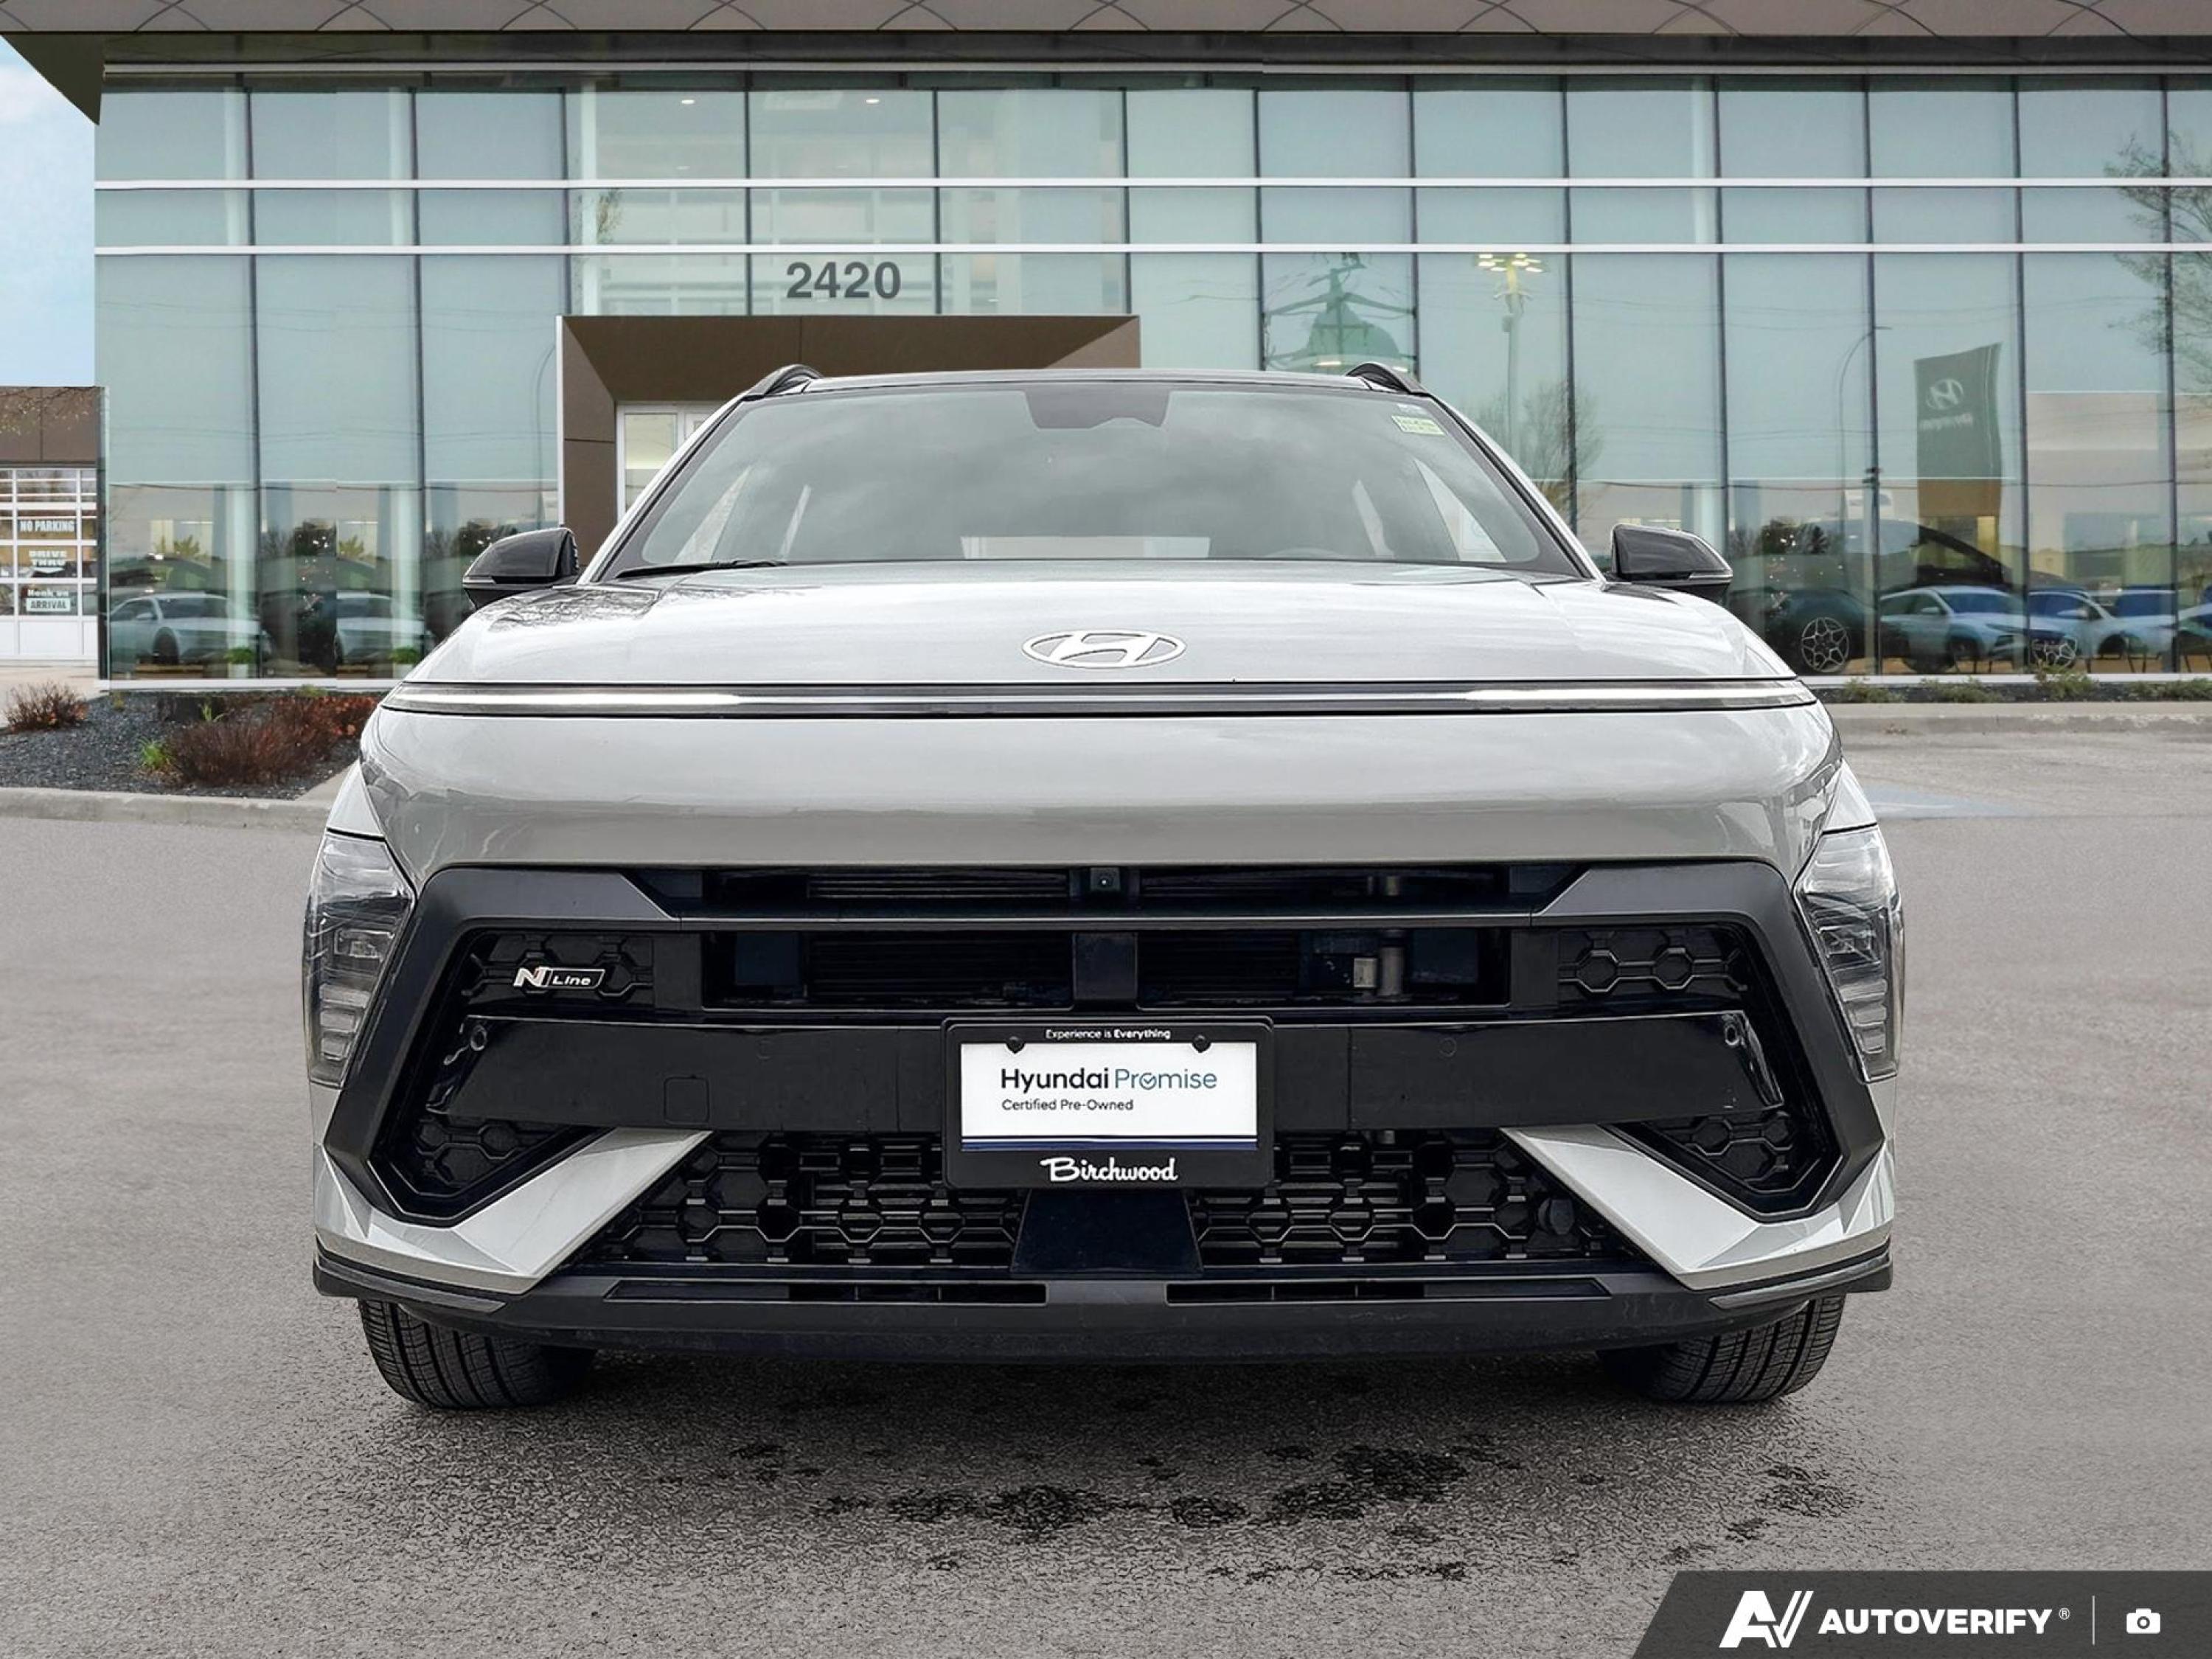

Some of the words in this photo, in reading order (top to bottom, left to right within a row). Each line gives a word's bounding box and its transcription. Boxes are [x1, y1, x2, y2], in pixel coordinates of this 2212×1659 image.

[787, 261, 901, 299] 2420
[20, 520, 33, 532] NO
[35, 520, 75, 532] PARKING
[29, 550, 67, 558] DRIVE
[29, 600, 67, 609] ARRIVAL
[552, 975, 591, 986] Line
[1046, 1029, 1102, 1040] Experience
[1104, 1029, 1112, 1039] is
[1113, 1029, 1172, 1040] Everything
[1001, 1067, 1109, 1094] Hyundai
[1114, 1068, 1217, 1091] Promise
[1001, 1098, 1057, 1110] Certified
[1060, 1099, 1134, 1110] Pre-Owned
[1040, 1156, 1179, 1182] Birchwood
